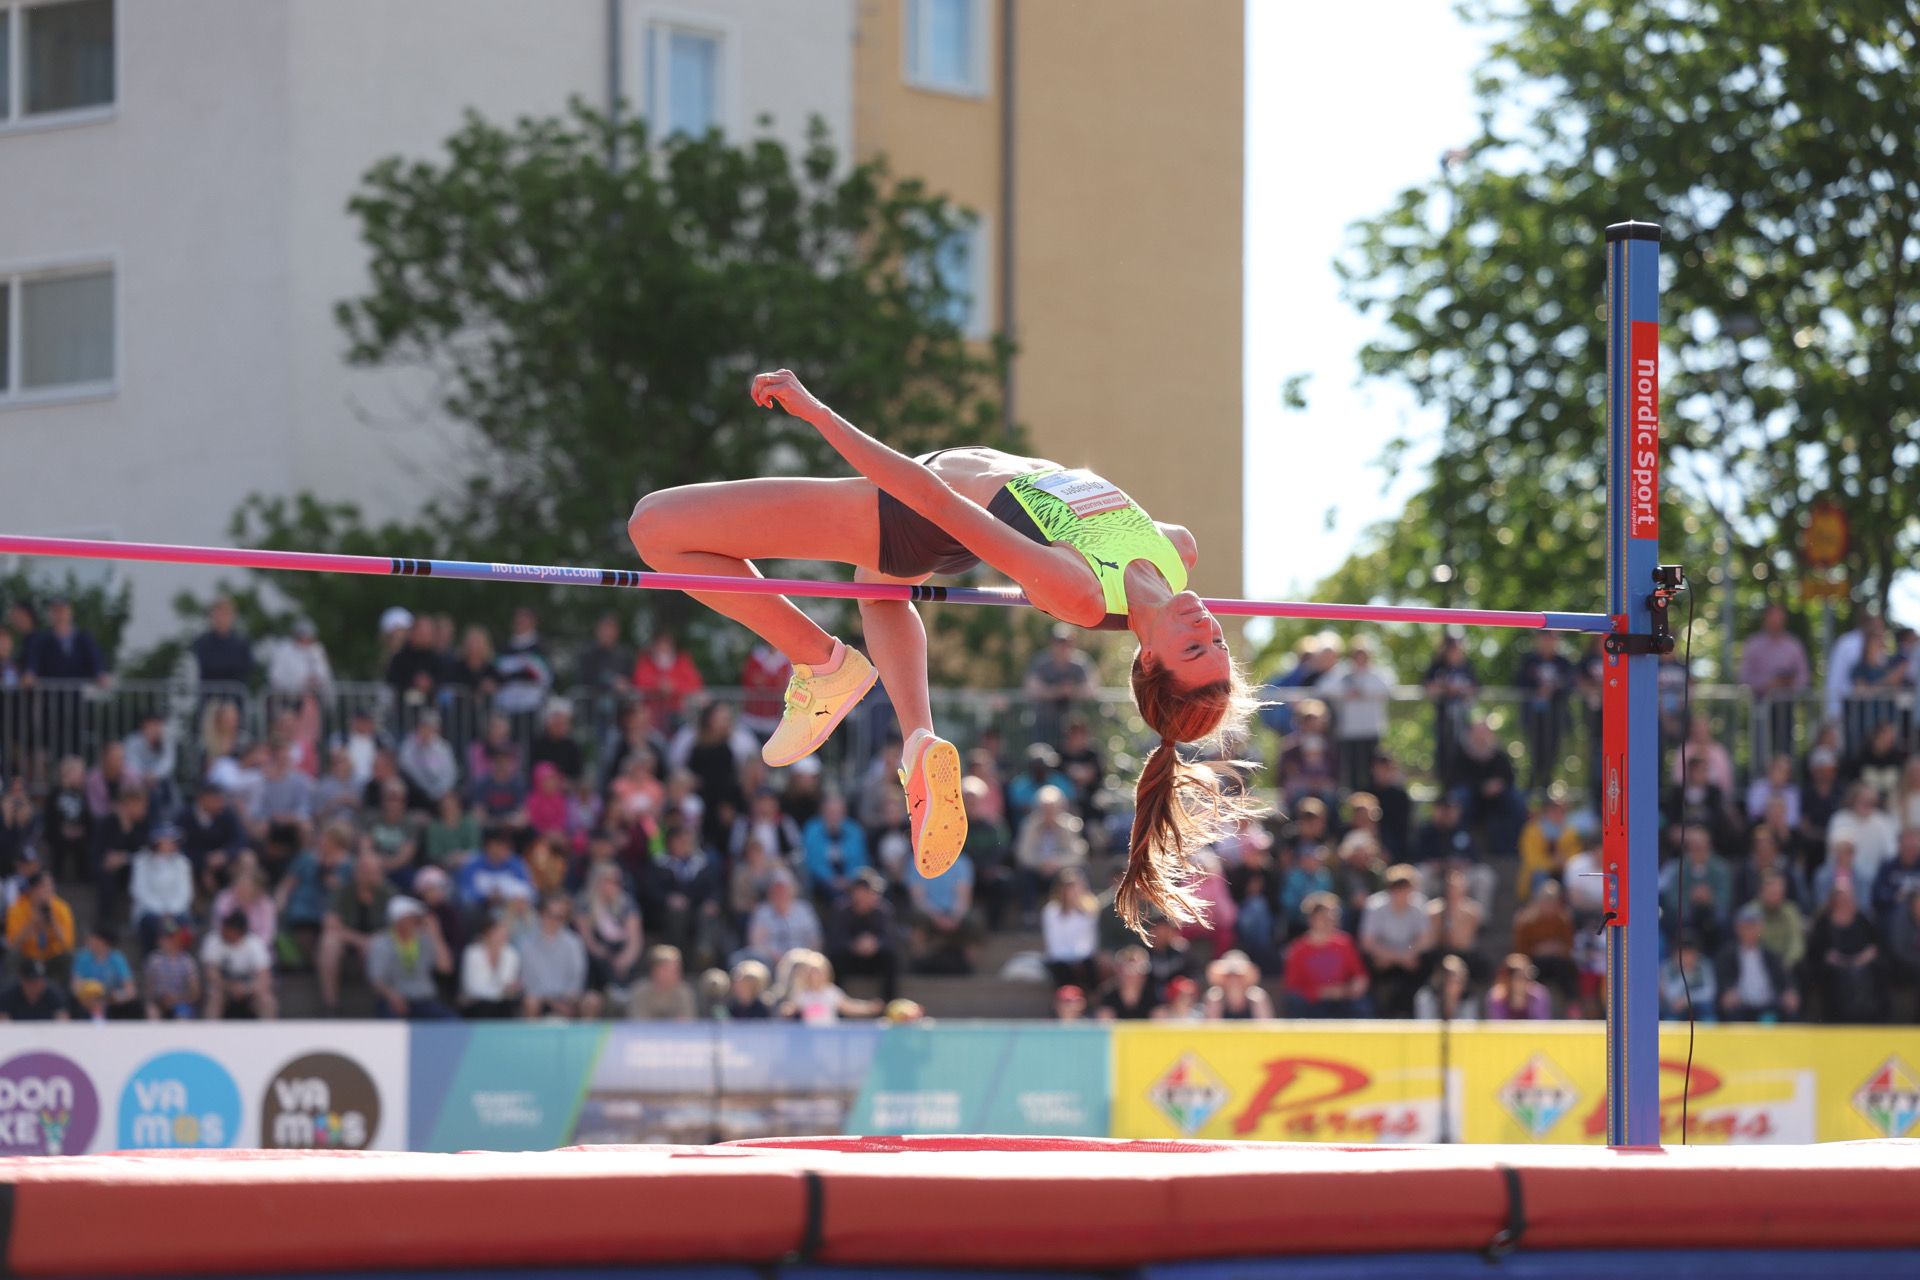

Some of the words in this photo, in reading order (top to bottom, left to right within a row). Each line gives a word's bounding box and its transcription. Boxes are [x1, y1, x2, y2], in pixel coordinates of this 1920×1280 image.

[1637, 359, 1658, 445] nordic
[1633, 450, 1655, 525] Sport
[491, 563, 600, 579] nordicsport.com
[1232, 1052, 1420, 1137] Paras
